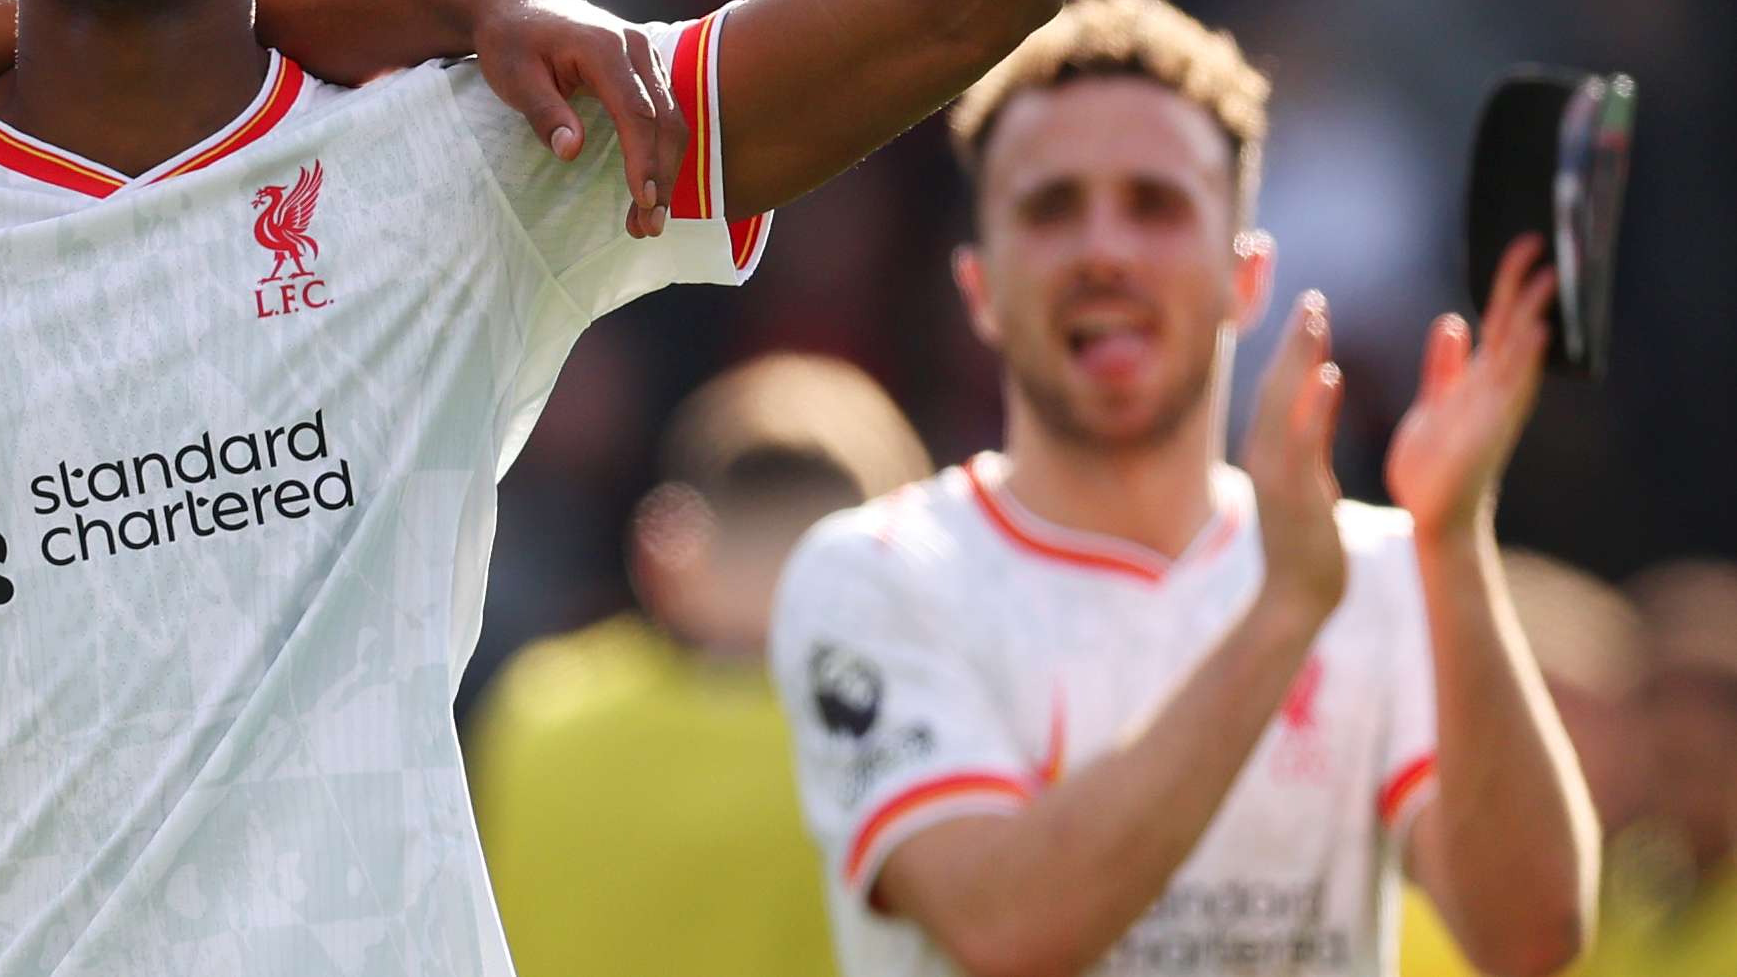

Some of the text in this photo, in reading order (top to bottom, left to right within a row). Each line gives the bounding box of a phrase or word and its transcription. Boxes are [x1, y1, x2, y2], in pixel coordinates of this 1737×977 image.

[255, 280, 334, 318] L.F.C.
[30, 408, 328, 515] standard
[41, 458, 355, 567] chartered
